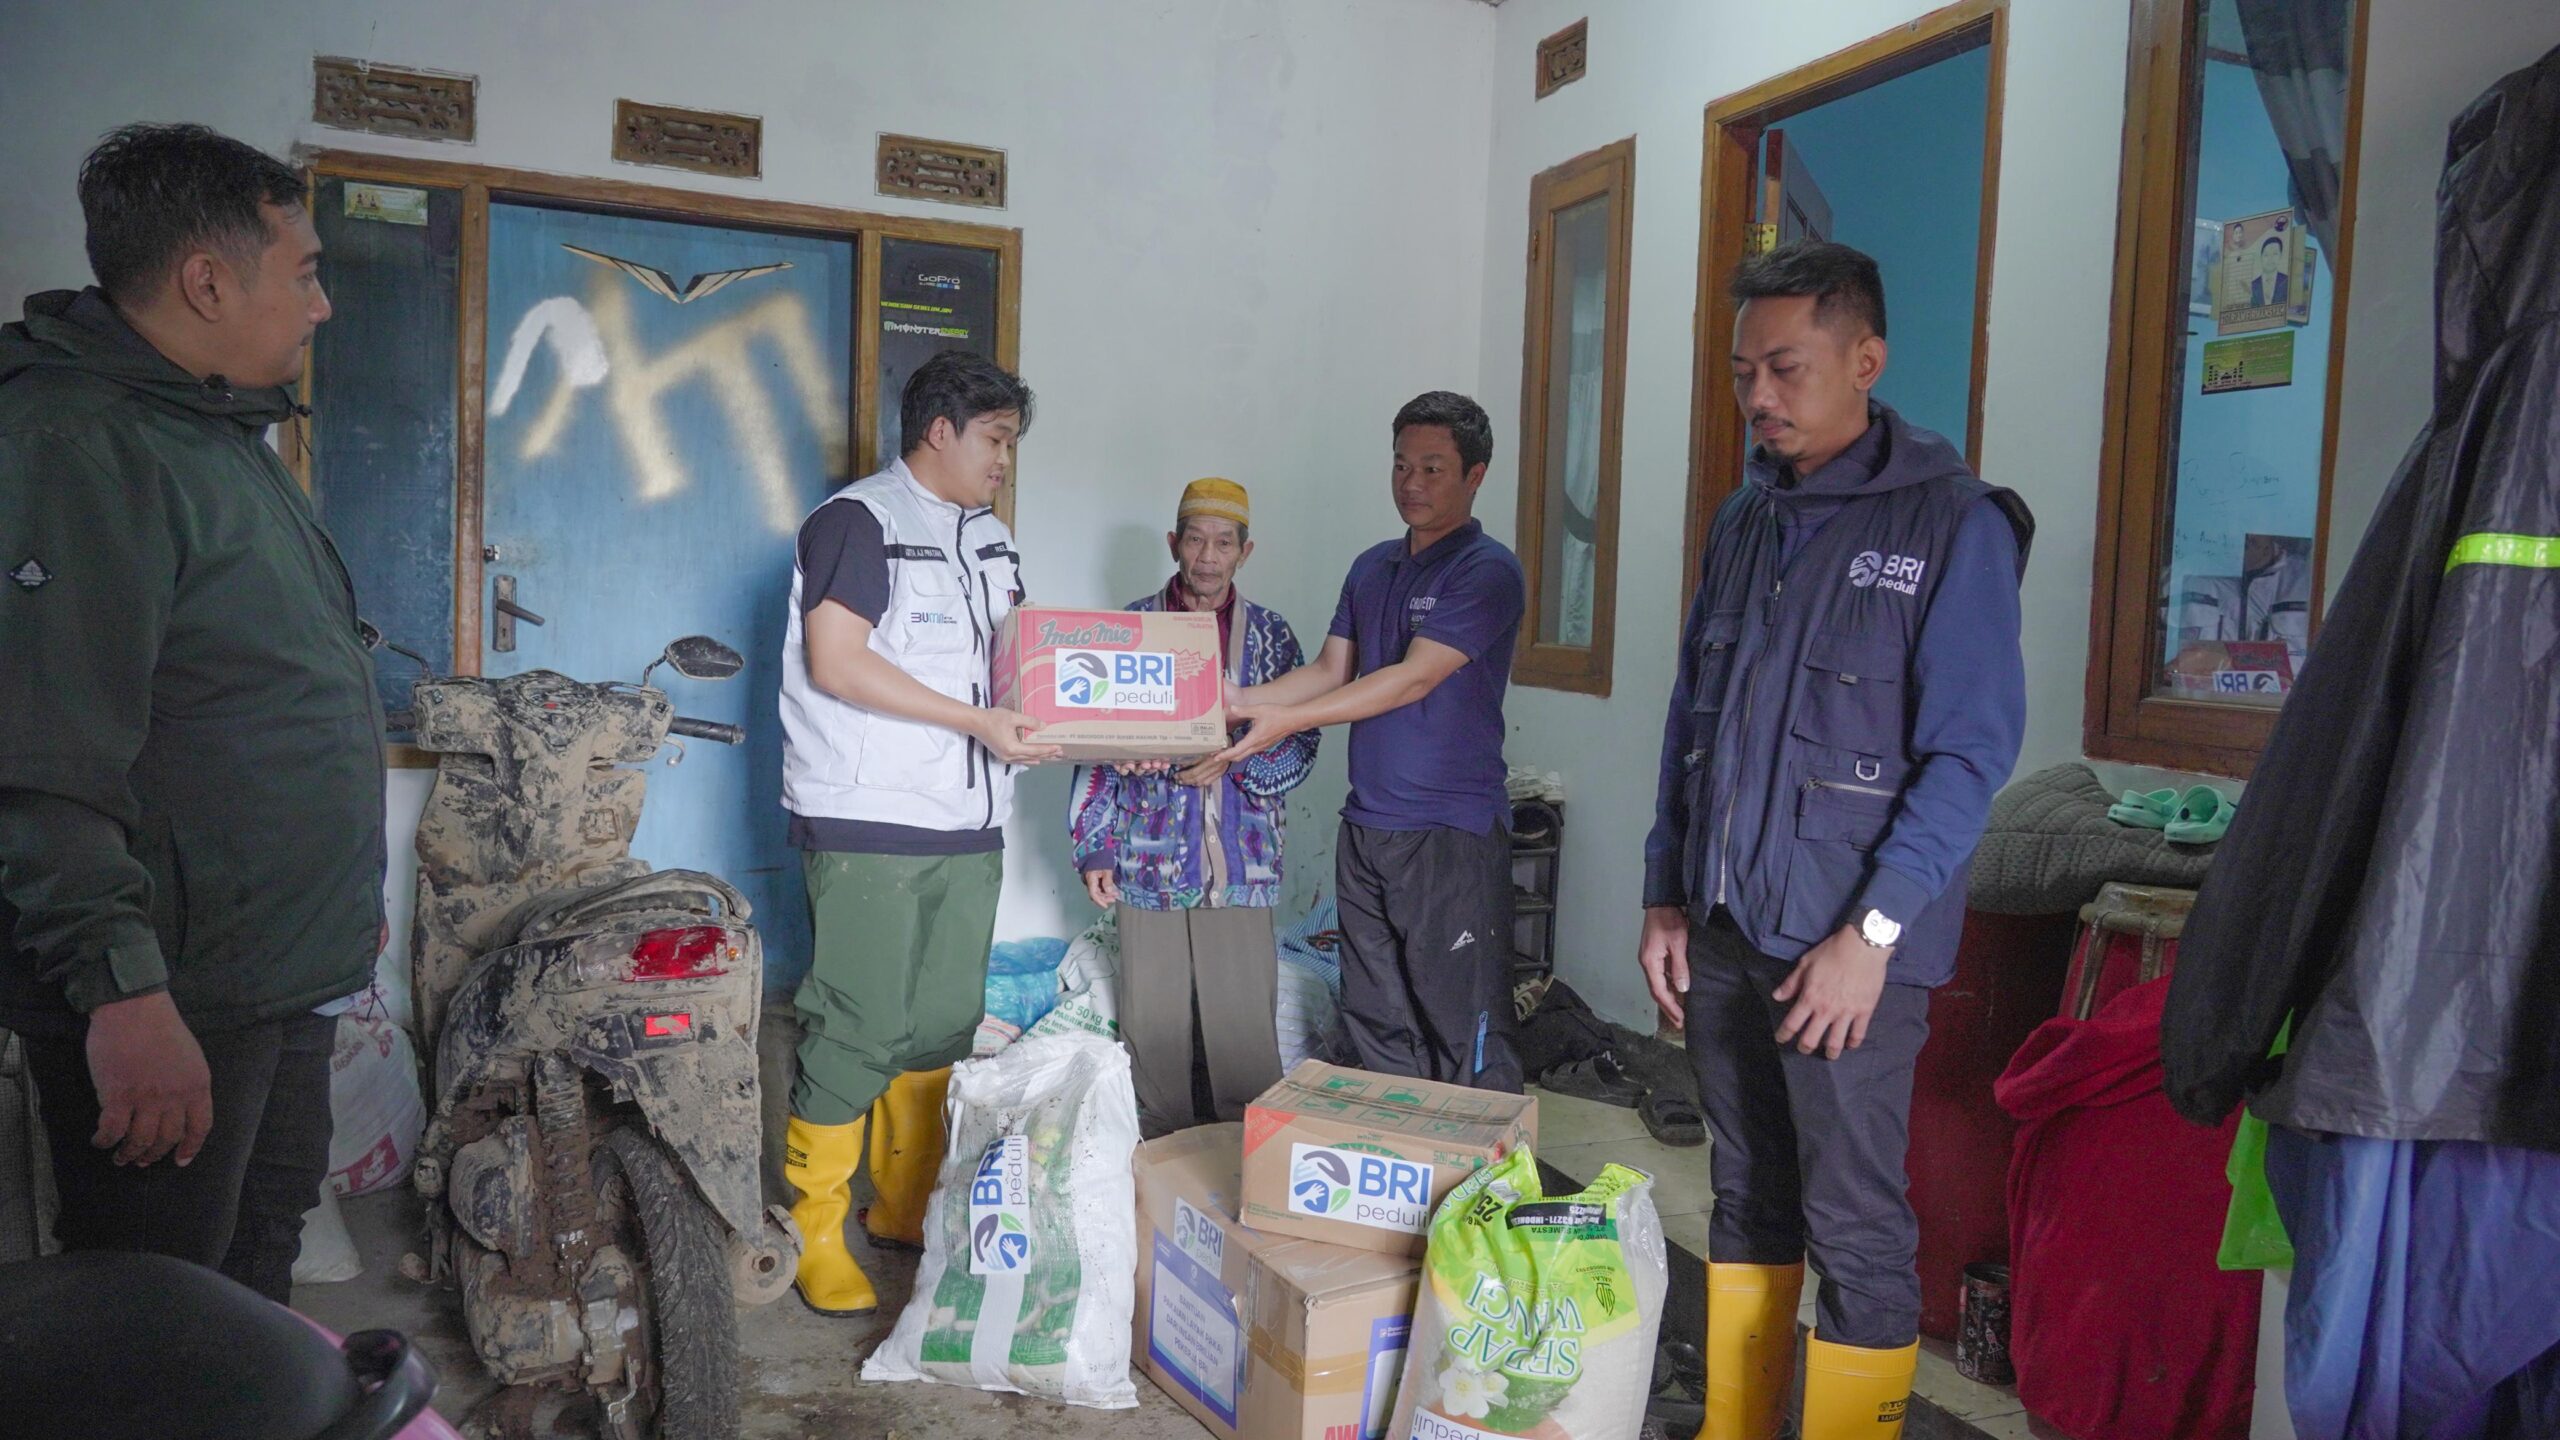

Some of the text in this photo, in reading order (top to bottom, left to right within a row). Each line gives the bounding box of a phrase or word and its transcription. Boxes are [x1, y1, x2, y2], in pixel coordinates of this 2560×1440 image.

[918, 274, 960, 284] GoPro
[1882, 554, 1925, 583] BRI
[1876, 577, 1917, 596] peduli
[1115, 654, 1172, 686] BRI
[1115, 689, 1173, 706] peduli
[1075, 1006, 1090, 1019] 50
[1090, 1011, 1103, 1026] kg
[972, 1138, 1005, 1206] BRI
[1008, 1137, 1026, 1206] peduli
[1358, 1158, 1431, 1206] BRI
[1357, 1201, 1430, 1229] peduli
[1474, 1194, 1503, 1223] 25
[1198, 1216, 1223, 1258] BRI
[1467, 1272, 1585, 1338] WANGI
[1450, 1321, 1579, 1378] SEDAP
